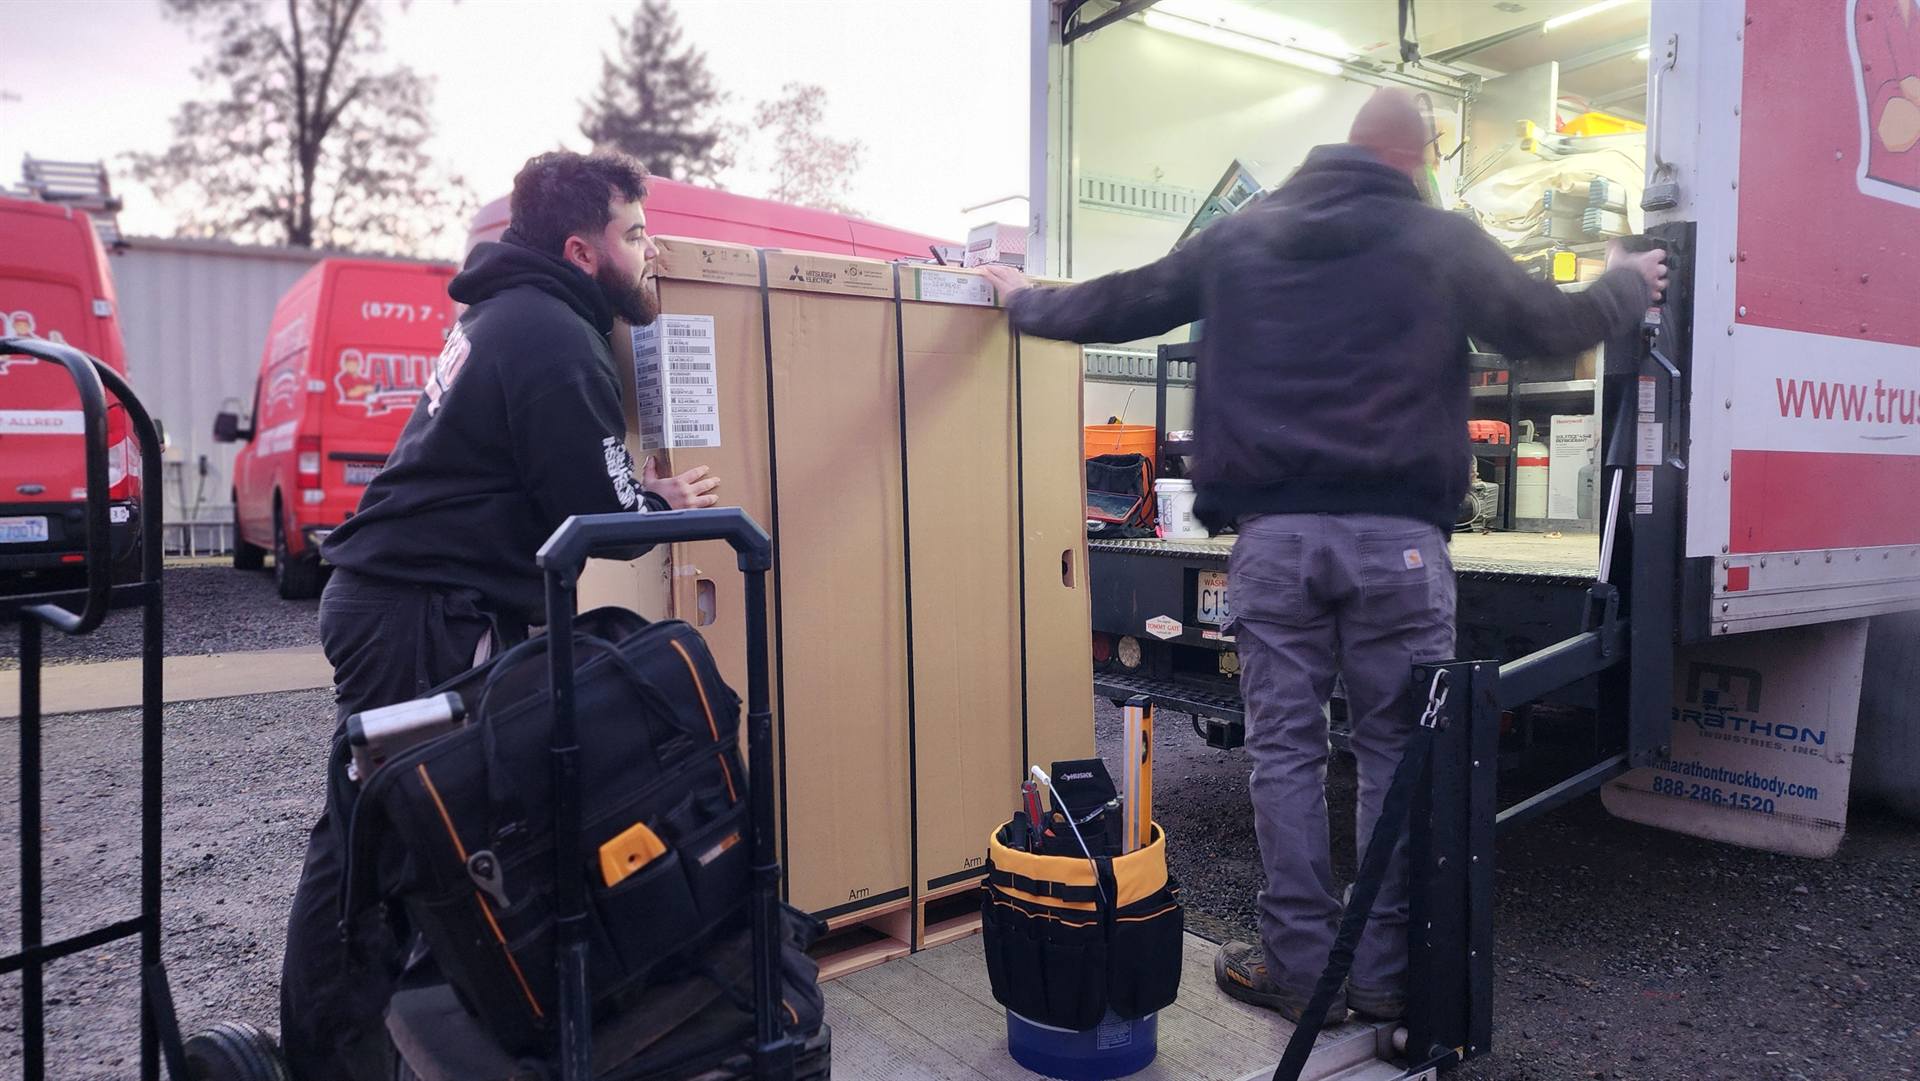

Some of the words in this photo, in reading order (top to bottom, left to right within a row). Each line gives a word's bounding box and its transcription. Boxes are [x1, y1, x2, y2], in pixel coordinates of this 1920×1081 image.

[362, 301, 414, 322] (877)
[369, 354, 438, 388] ALL
[9, 417, 64, 427] ALLRED
[1204, 579, 1226, 587] WASH
[1203, 589, 1230, 617] C15
[1653, 775, 1775, 815] 888-286-1520
[963, 856, 982, 869] Arm
[848, 886, 870, 901] Arm
